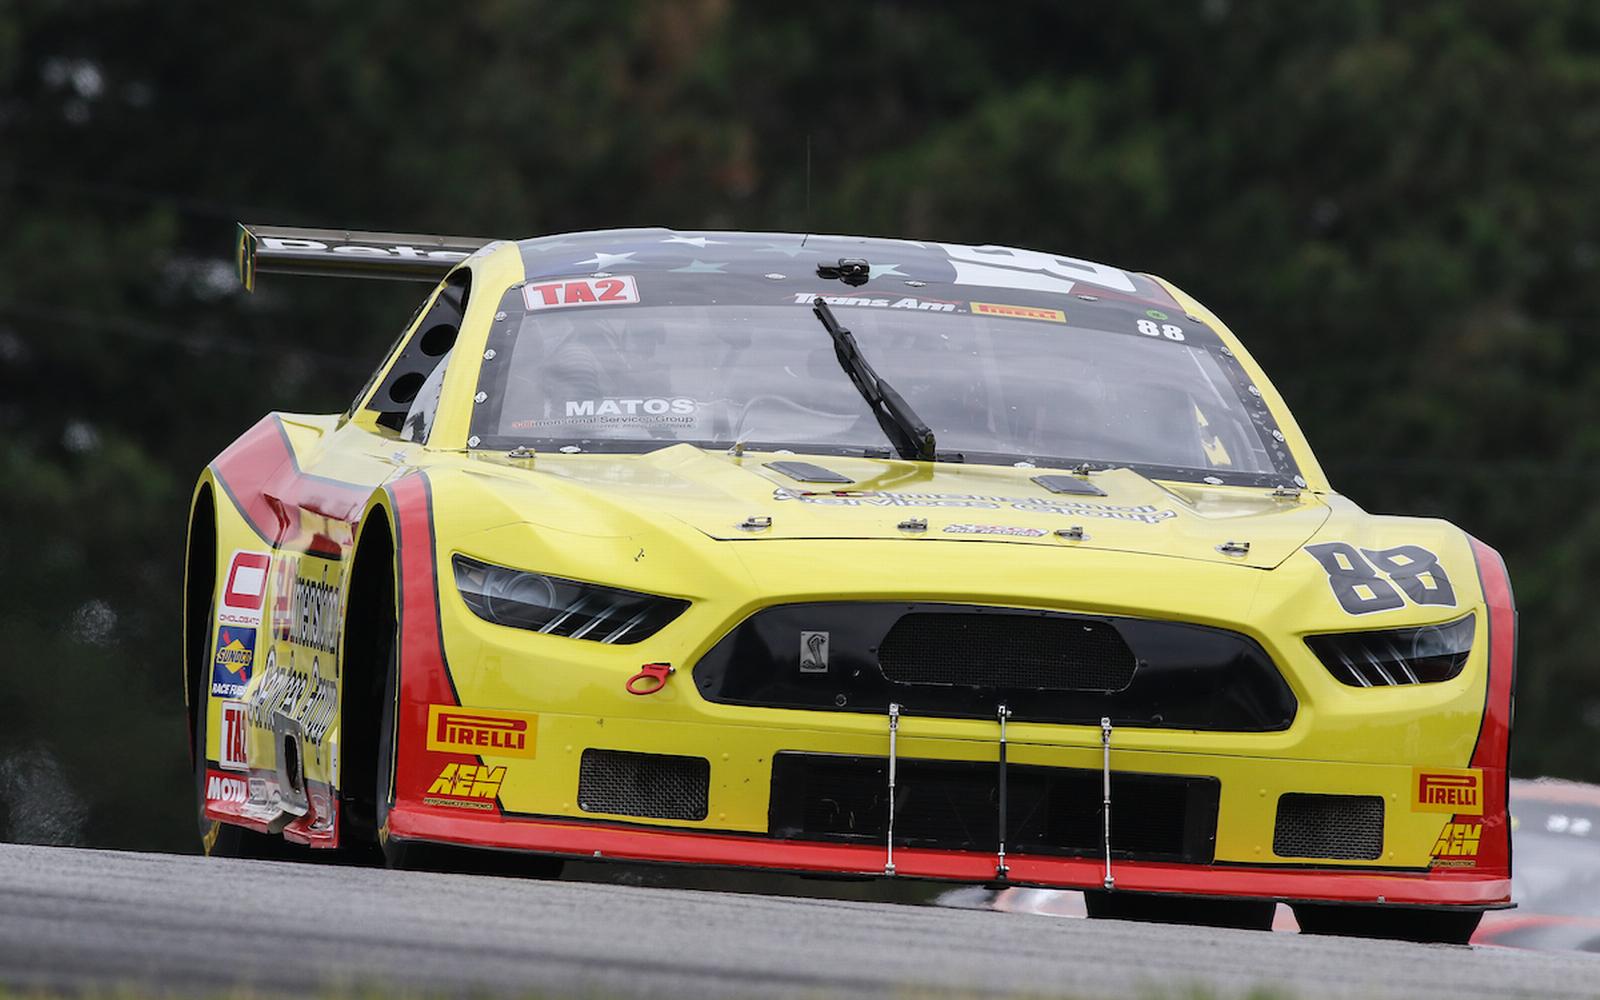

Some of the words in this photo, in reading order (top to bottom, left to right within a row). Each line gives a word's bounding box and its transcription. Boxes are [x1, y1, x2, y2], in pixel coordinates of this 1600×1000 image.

[533, 279, 627, 305] TA2
[890, 298, 955, 312] Am
[979, 304, 1057, 320] PIRELLI
[1136, 319, 1185, 341] 88
[566, 399, 695, 417] MATOS
[655, 416, 694, 425] Group
[1301, 542, 1457, 617] 88
[217, 648, 252, 665] SUNOCO
[437, 712, 527, 750] PIRELLI
[427, 762, 507, 799] AEM
[1418, 773, 1477, 806] PIRELLI
[1430, 822, 1482, 856] AEM
